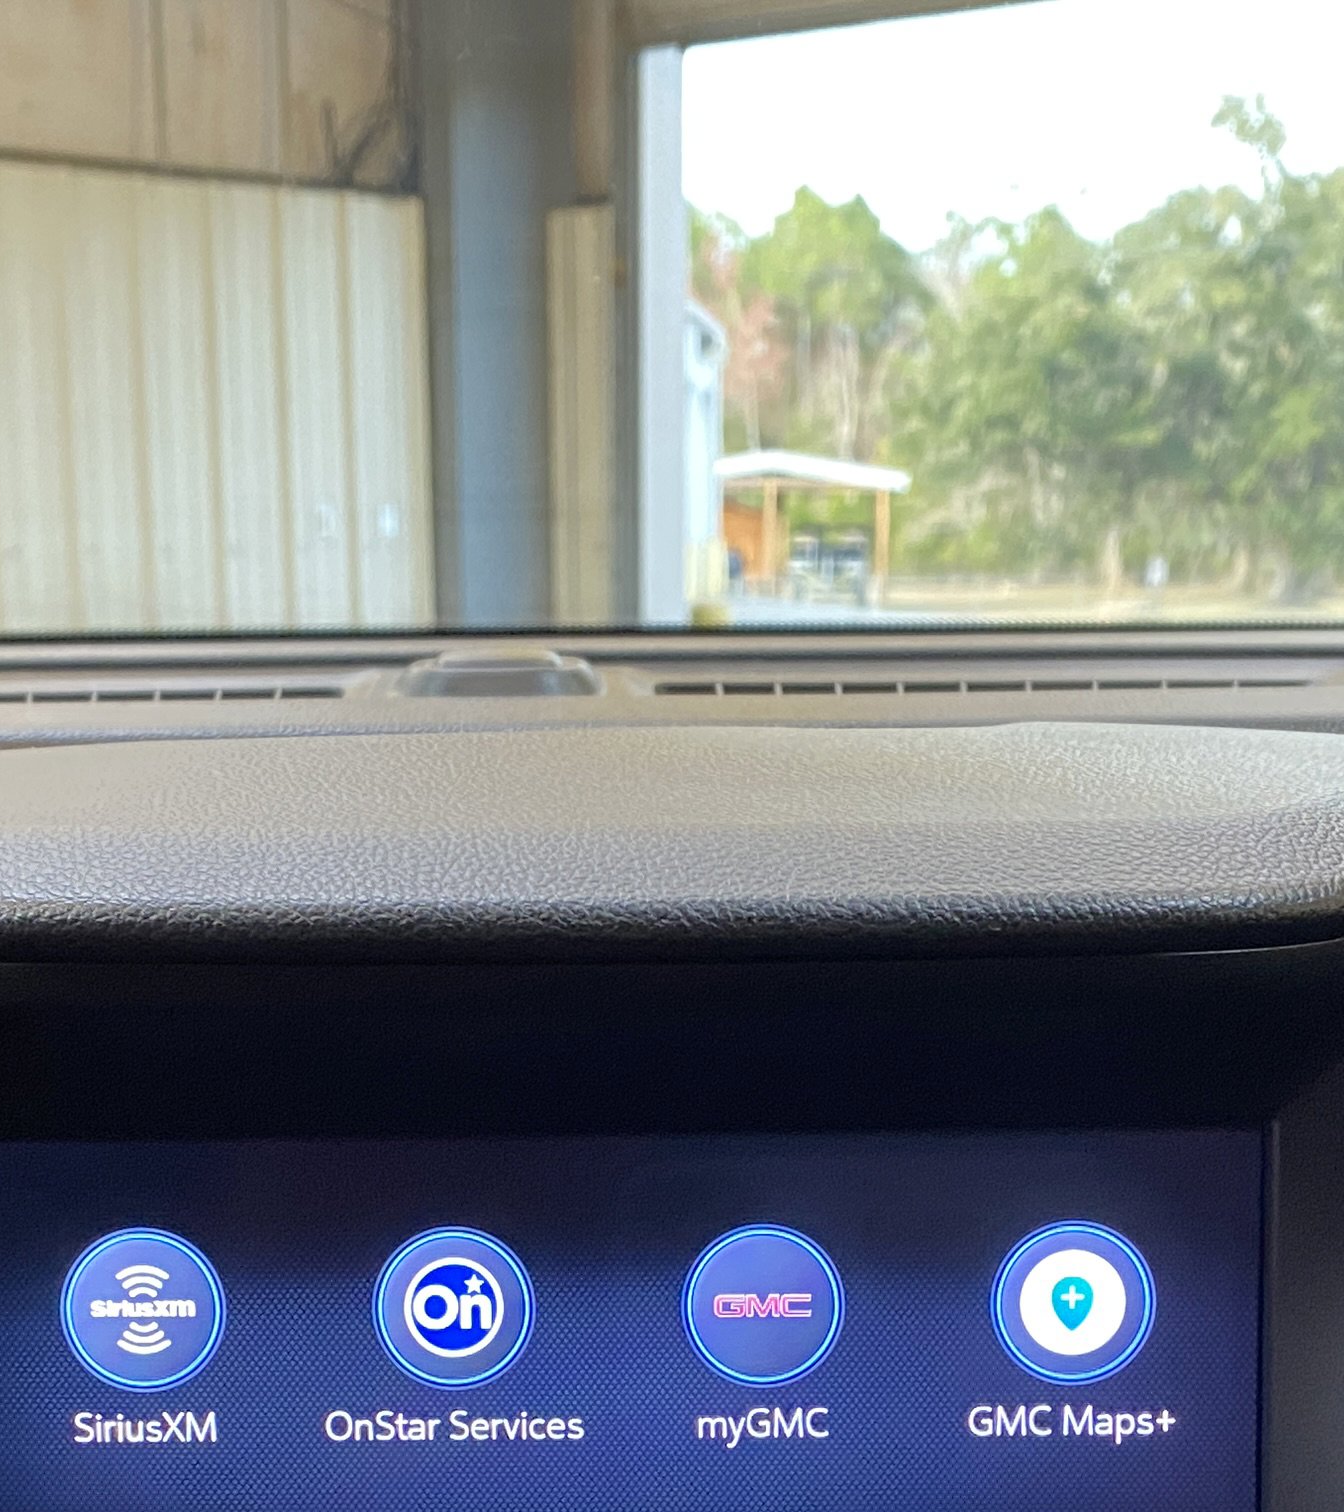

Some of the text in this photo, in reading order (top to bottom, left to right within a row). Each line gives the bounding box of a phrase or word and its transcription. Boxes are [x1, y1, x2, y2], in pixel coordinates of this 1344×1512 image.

[412, 1284, 493, 1331] On
[712, 1292, 813, 1319] GMC
[72, 1411, 218, 1445] SiriusXM
[325, 1410, 586, 1442] OnStar Services
[697, 1406, 830, 1449] myGMC
[967, 1403, 1177, 1445] GMC Maps+
